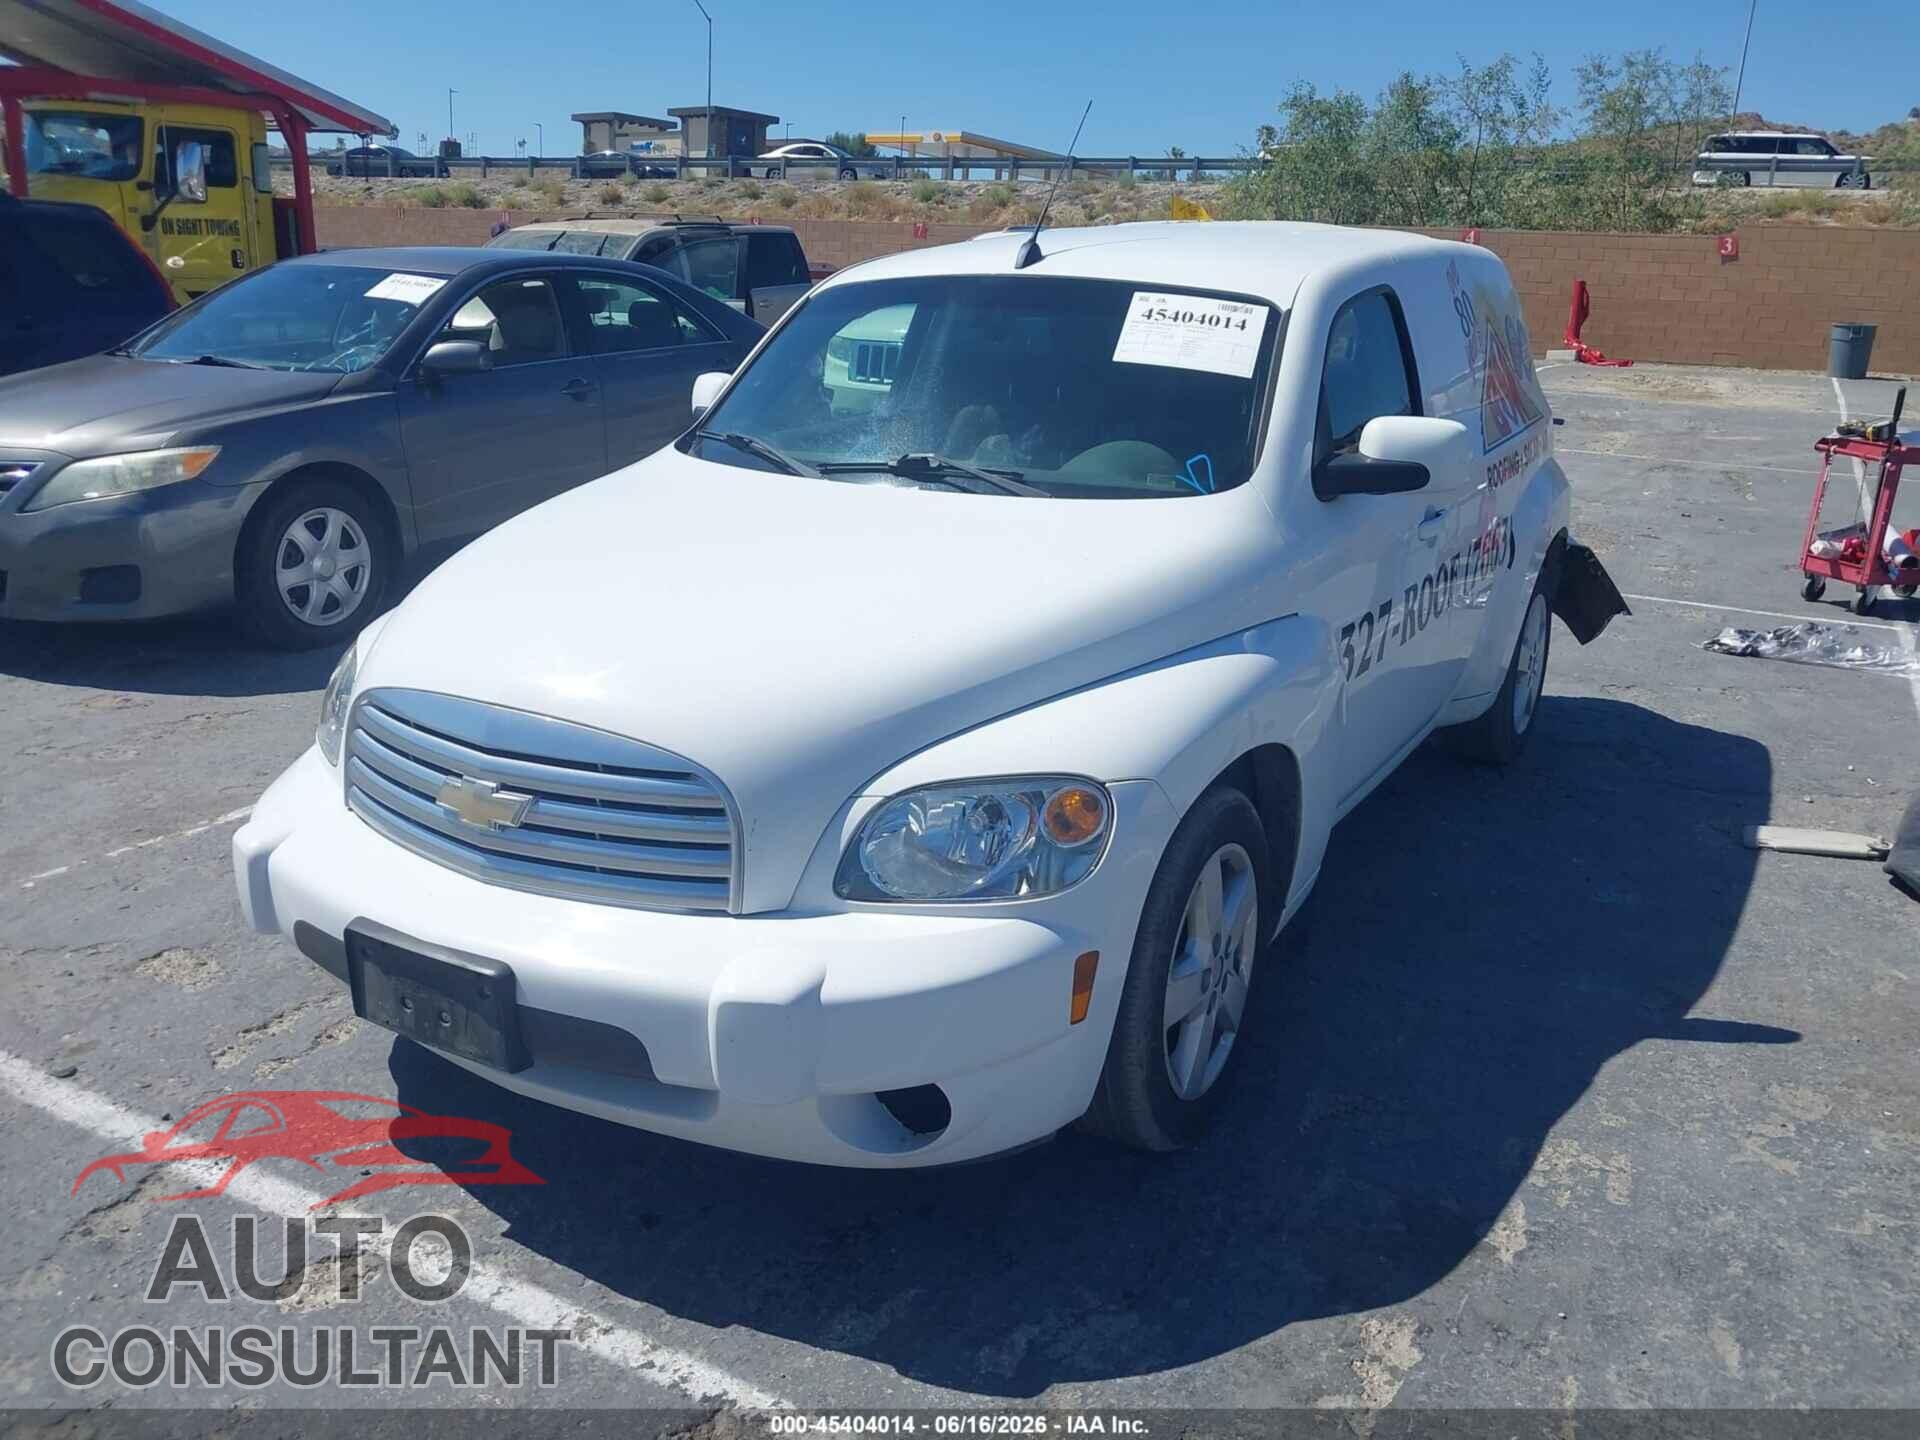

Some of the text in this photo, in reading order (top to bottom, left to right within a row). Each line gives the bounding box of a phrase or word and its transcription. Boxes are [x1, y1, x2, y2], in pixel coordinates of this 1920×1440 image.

[161, 217, 240, 237] ON SIGHT TOWING
[1464, 229, 1475, 243] 4
[1720, 237, 1733, 254] 3
[1141, 307, 1248, 331] 45404014
